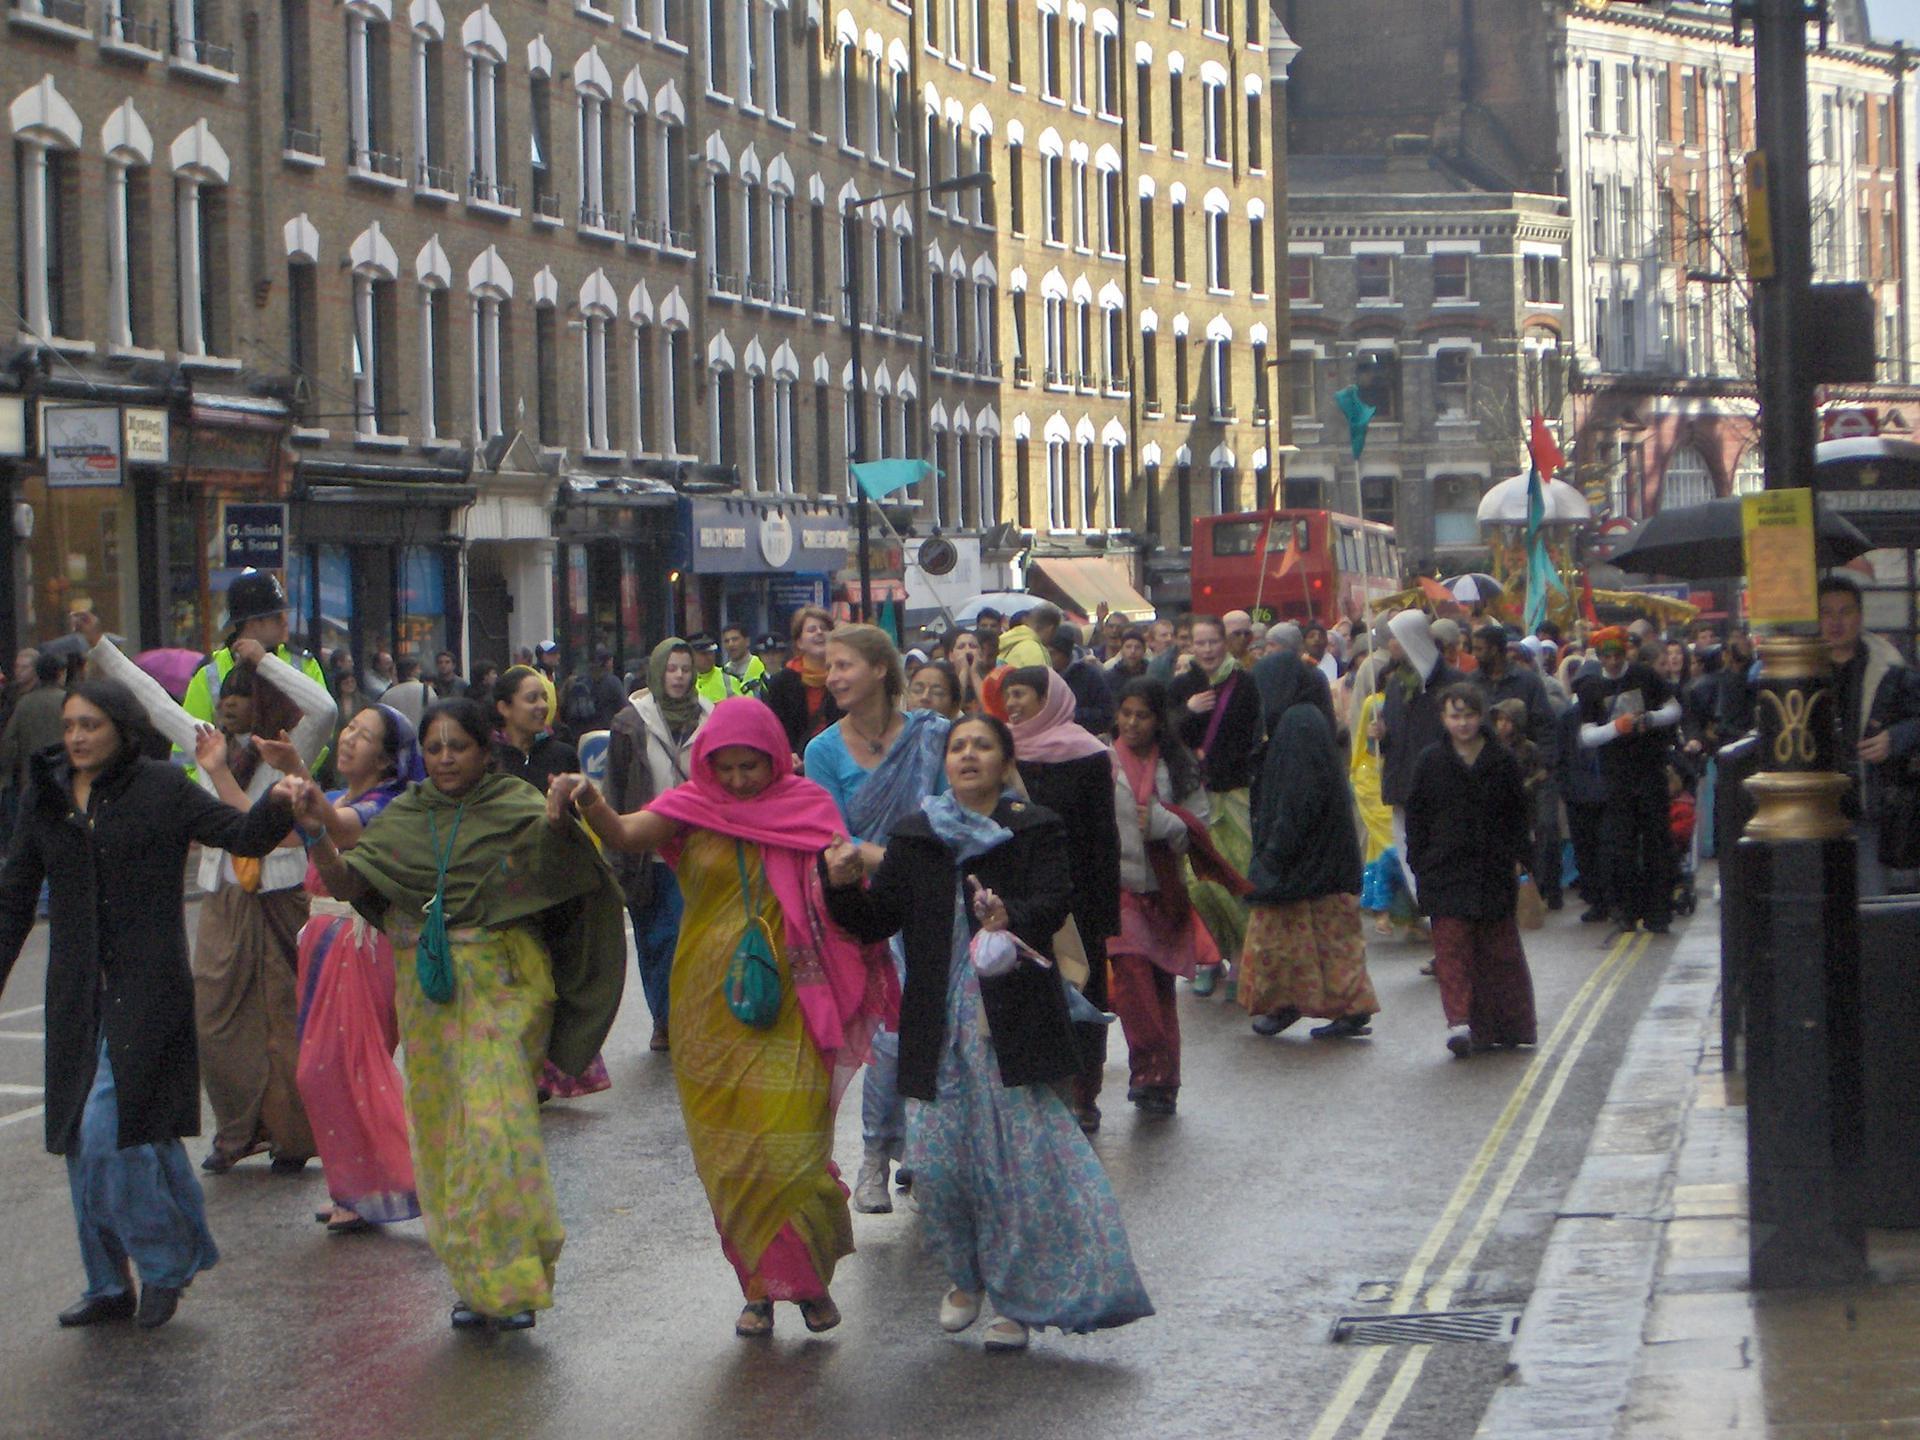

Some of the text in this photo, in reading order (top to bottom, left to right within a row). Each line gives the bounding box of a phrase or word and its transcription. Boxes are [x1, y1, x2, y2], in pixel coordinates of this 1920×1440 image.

[1758, 503, 1796, 514] PUBLIC
[1758, 516, 1797, 526] NOTICE
[244, 523, 281, 537] Smith
[231, 538, 278, 551] & Sons
